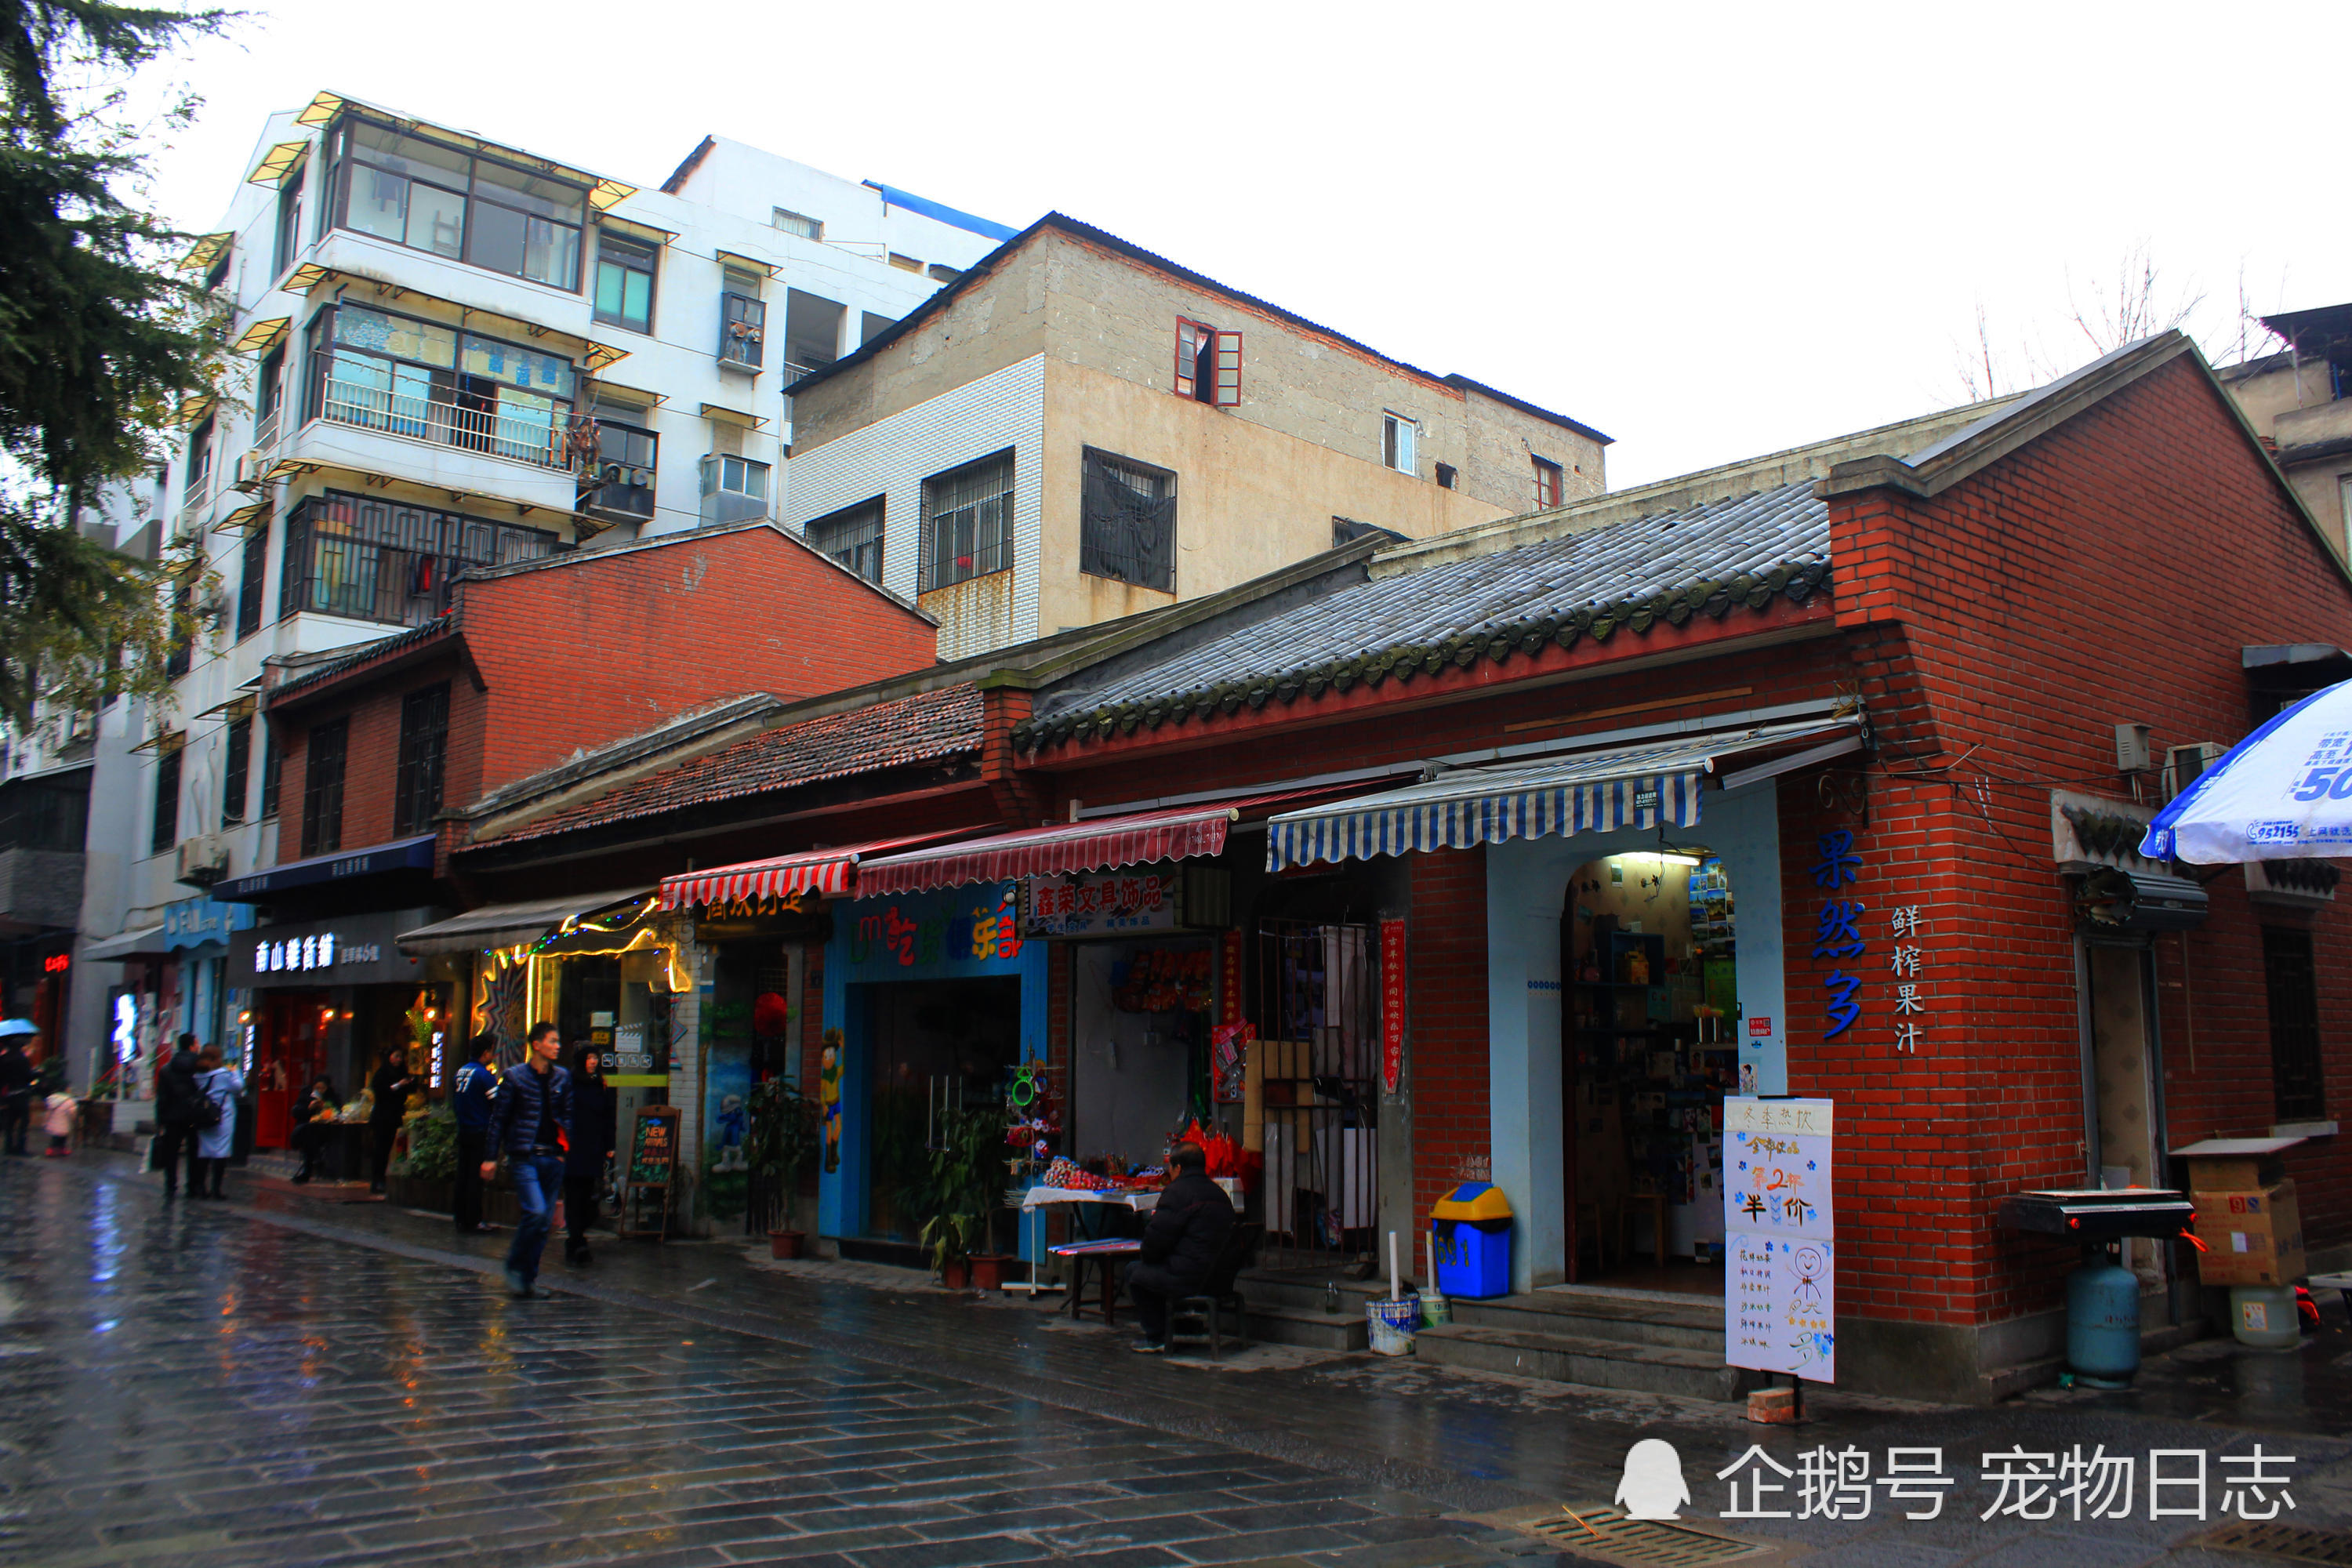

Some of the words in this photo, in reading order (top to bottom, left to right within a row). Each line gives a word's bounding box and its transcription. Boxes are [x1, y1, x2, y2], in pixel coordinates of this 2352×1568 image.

[1037, 875, 1162, 916] 鑫荣文具饰品
[1808, 829, 1864, 1040] 果然多
[1889, 905, 1925, 1055] 鲜榨果汁
[645, 1127, 667, 1138] NEW
